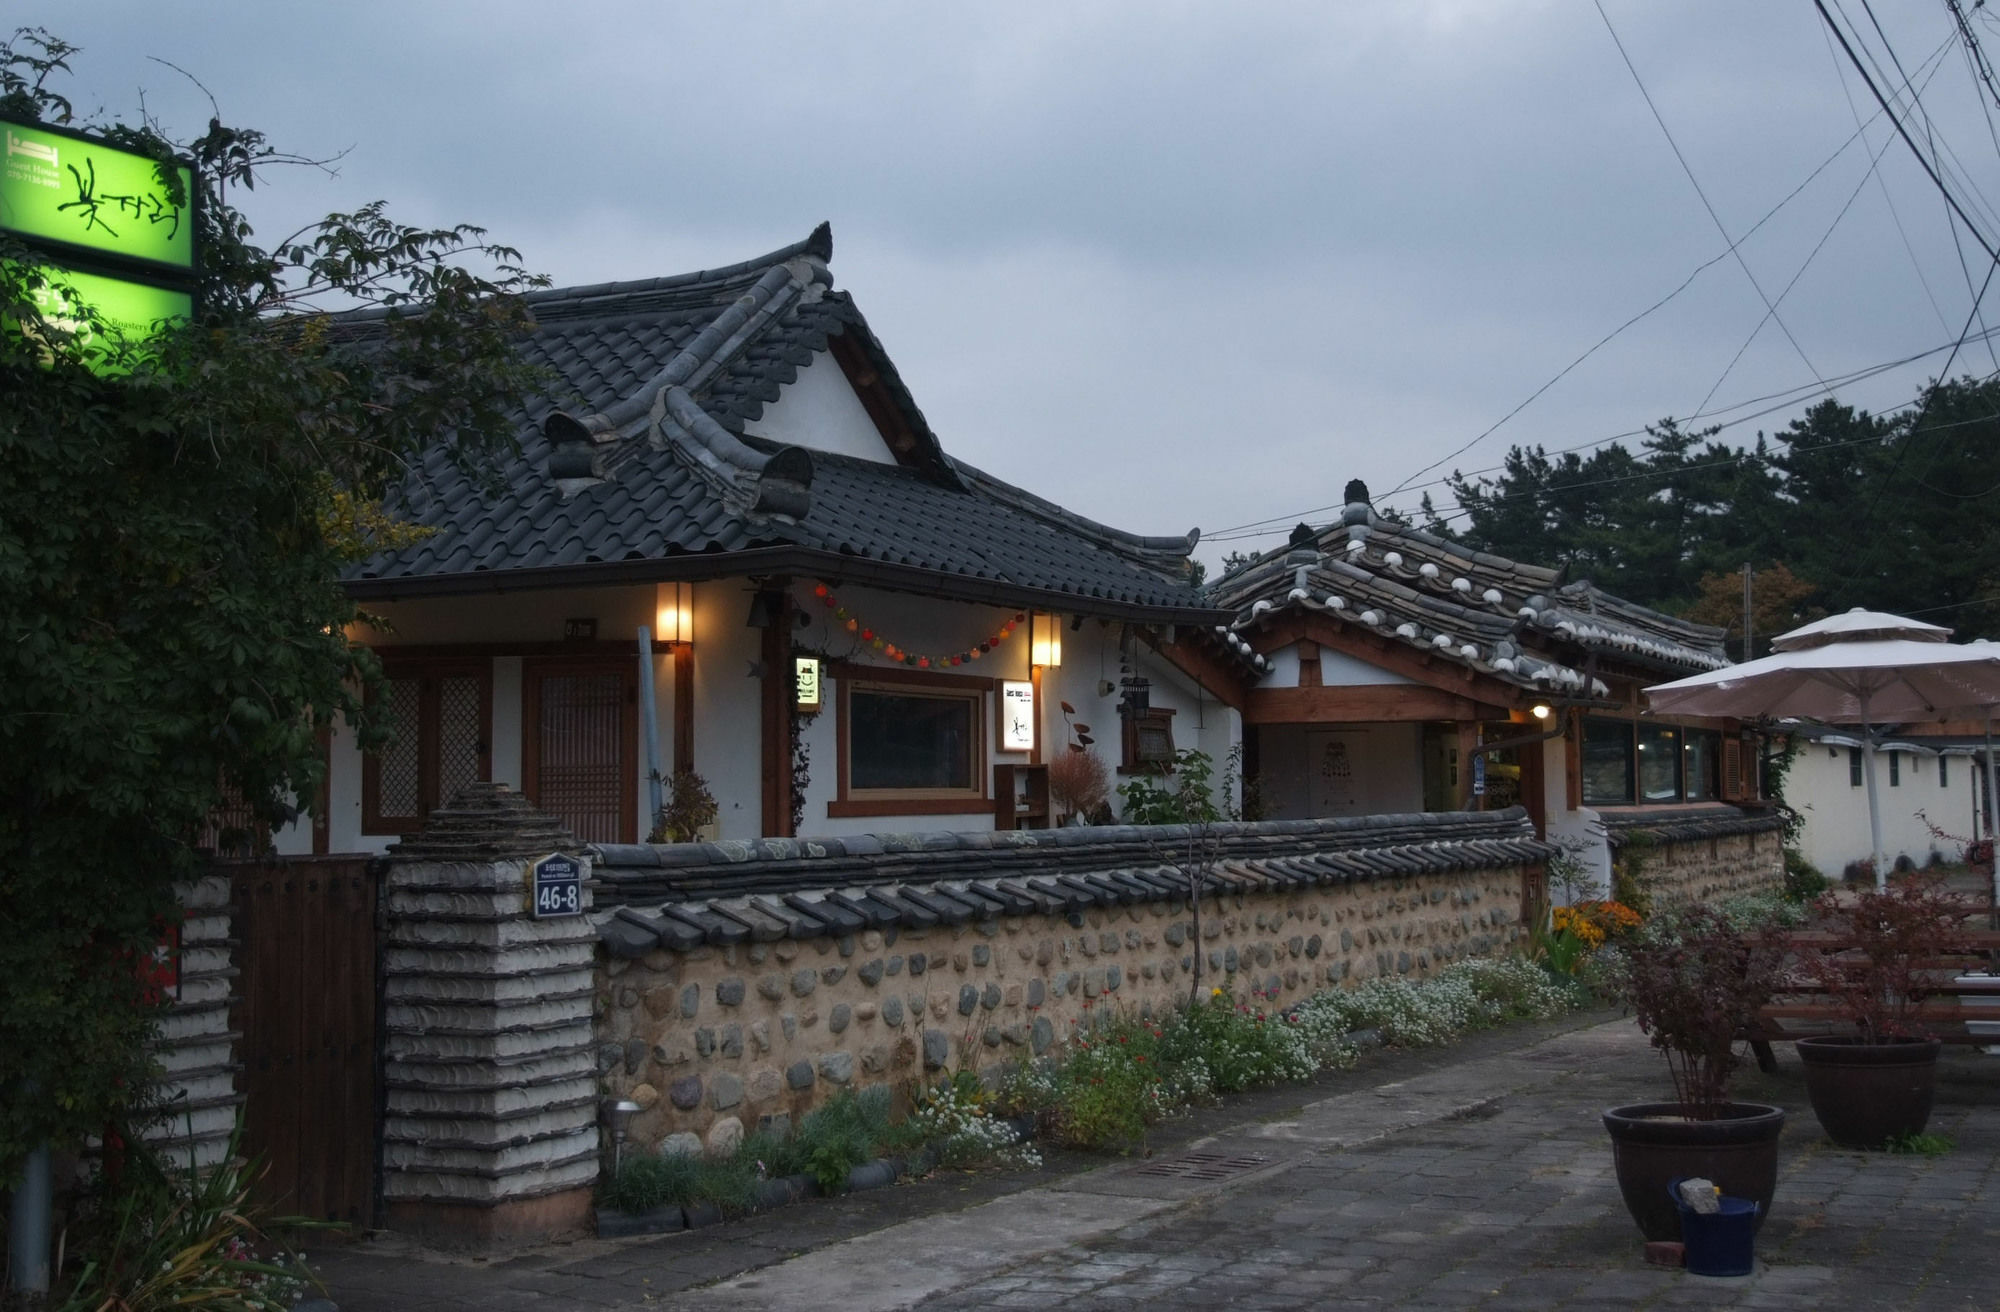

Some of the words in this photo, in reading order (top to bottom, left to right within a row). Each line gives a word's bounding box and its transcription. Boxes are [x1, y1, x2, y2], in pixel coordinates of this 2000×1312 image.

[57, 157, 179, 240] 꽃자리
[112, 318, 148, 333] Roastery
[539, 885, 577, 910] 46-8
